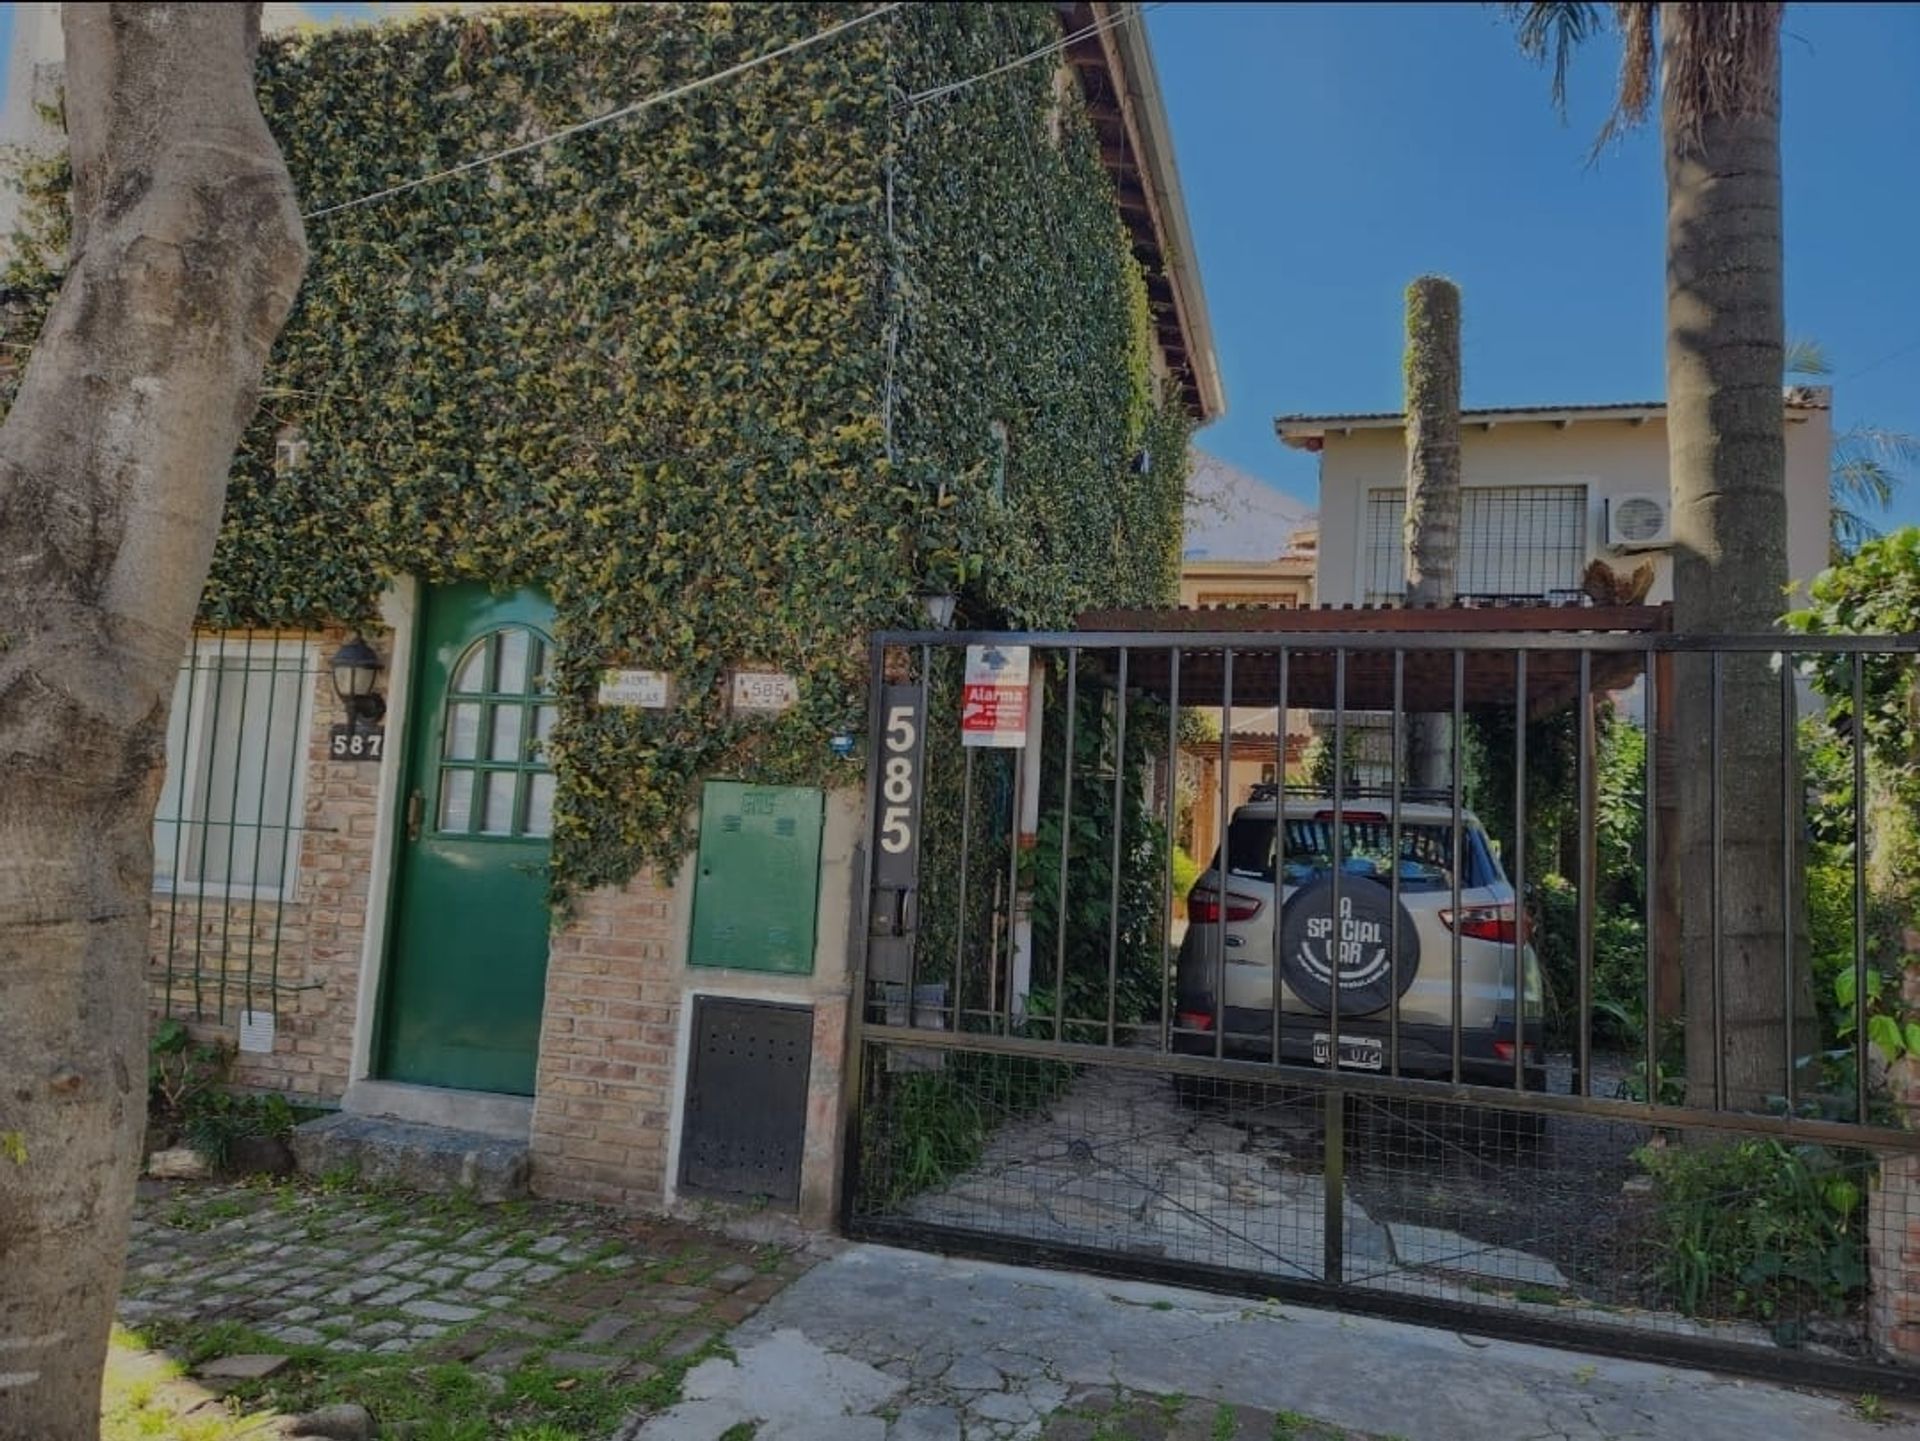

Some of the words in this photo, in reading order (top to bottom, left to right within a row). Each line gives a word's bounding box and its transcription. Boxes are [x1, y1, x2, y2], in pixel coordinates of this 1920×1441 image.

[751, 681, 784, 698] 585
[968, 686, 1023, 702] Alarma
[333, 734, 382, 756] 587
[881, 706, 916, 854] 585
[1339, 896, 1352, 919] A
[1306, 917, 1382, 943] SPCIAL
